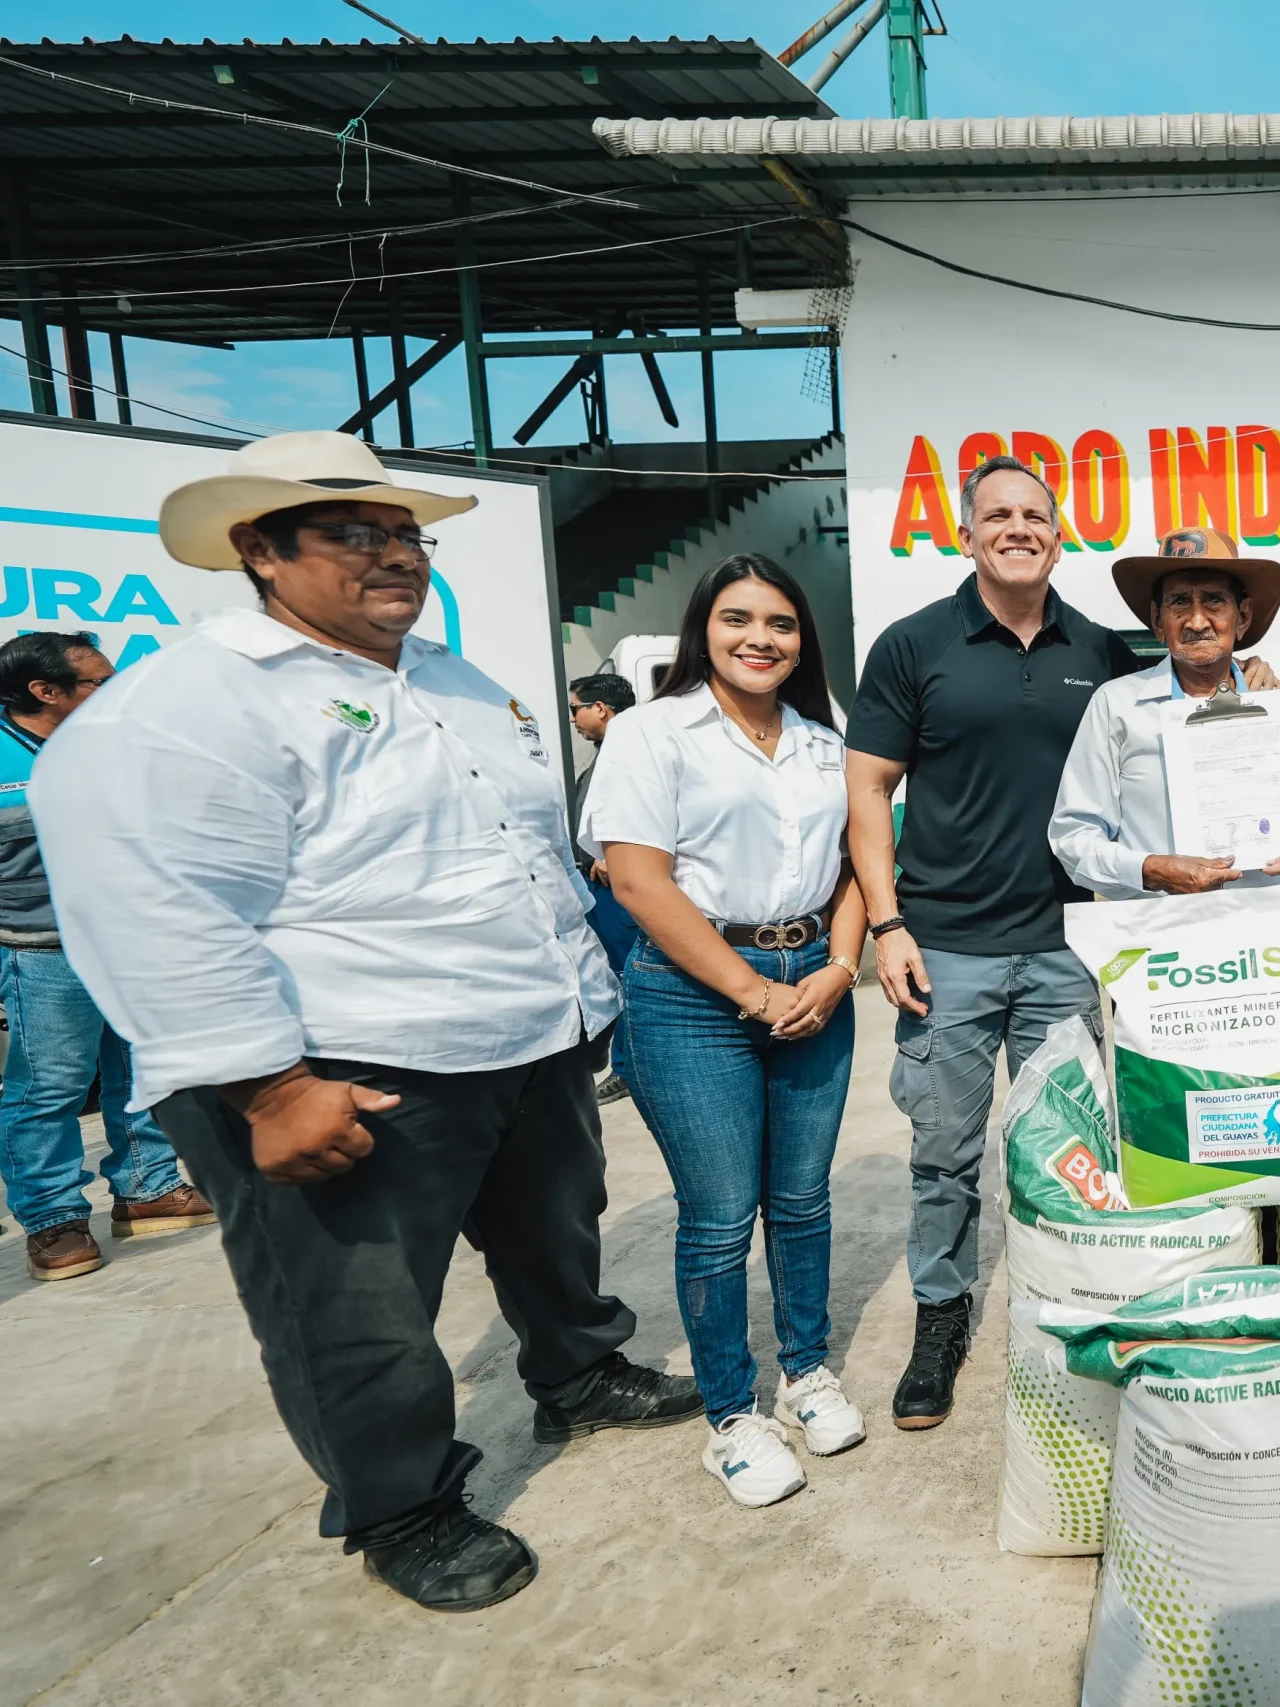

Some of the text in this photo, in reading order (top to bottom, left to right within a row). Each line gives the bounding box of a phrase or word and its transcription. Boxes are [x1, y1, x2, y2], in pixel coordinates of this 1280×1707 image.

[1150, 1004, 1238, 1022] FERTILIZANTE
[1151, 1015, 1276, 1036] MICRONIZADO
[1195, 1094, 1242, 1104] PRODUCTO
[1201, 1112, 1259, 1121] PREFECTURA
[1202, 1122, 1258, 1132] CIUDADANA
[1203, 1132, 1259, 1142] DEL GUAYAS
[1199, 1149, 1246, 1158] PROHIBIDA
[1248, 1148, 1260, 1156] SU
[1208, 1193, 1268, 1203] COMPOSICIÓN:
[1038, 1222, 1230, 1249] NITRO N38 ACTIVE RADICAL PAC
[1071, 1288, 1120, 1302] COMPOSICIÓN
[1146, 1385, 1189, 1402] INICIO
[1194, 1384, 1248, 1403] ACTIVE
[1162, 1449, 1173, 1463] (N)
[1185, 1443, 1241, 1460] COMPOSICIÓN
[1244, 1452, 1250, 1460] Y
